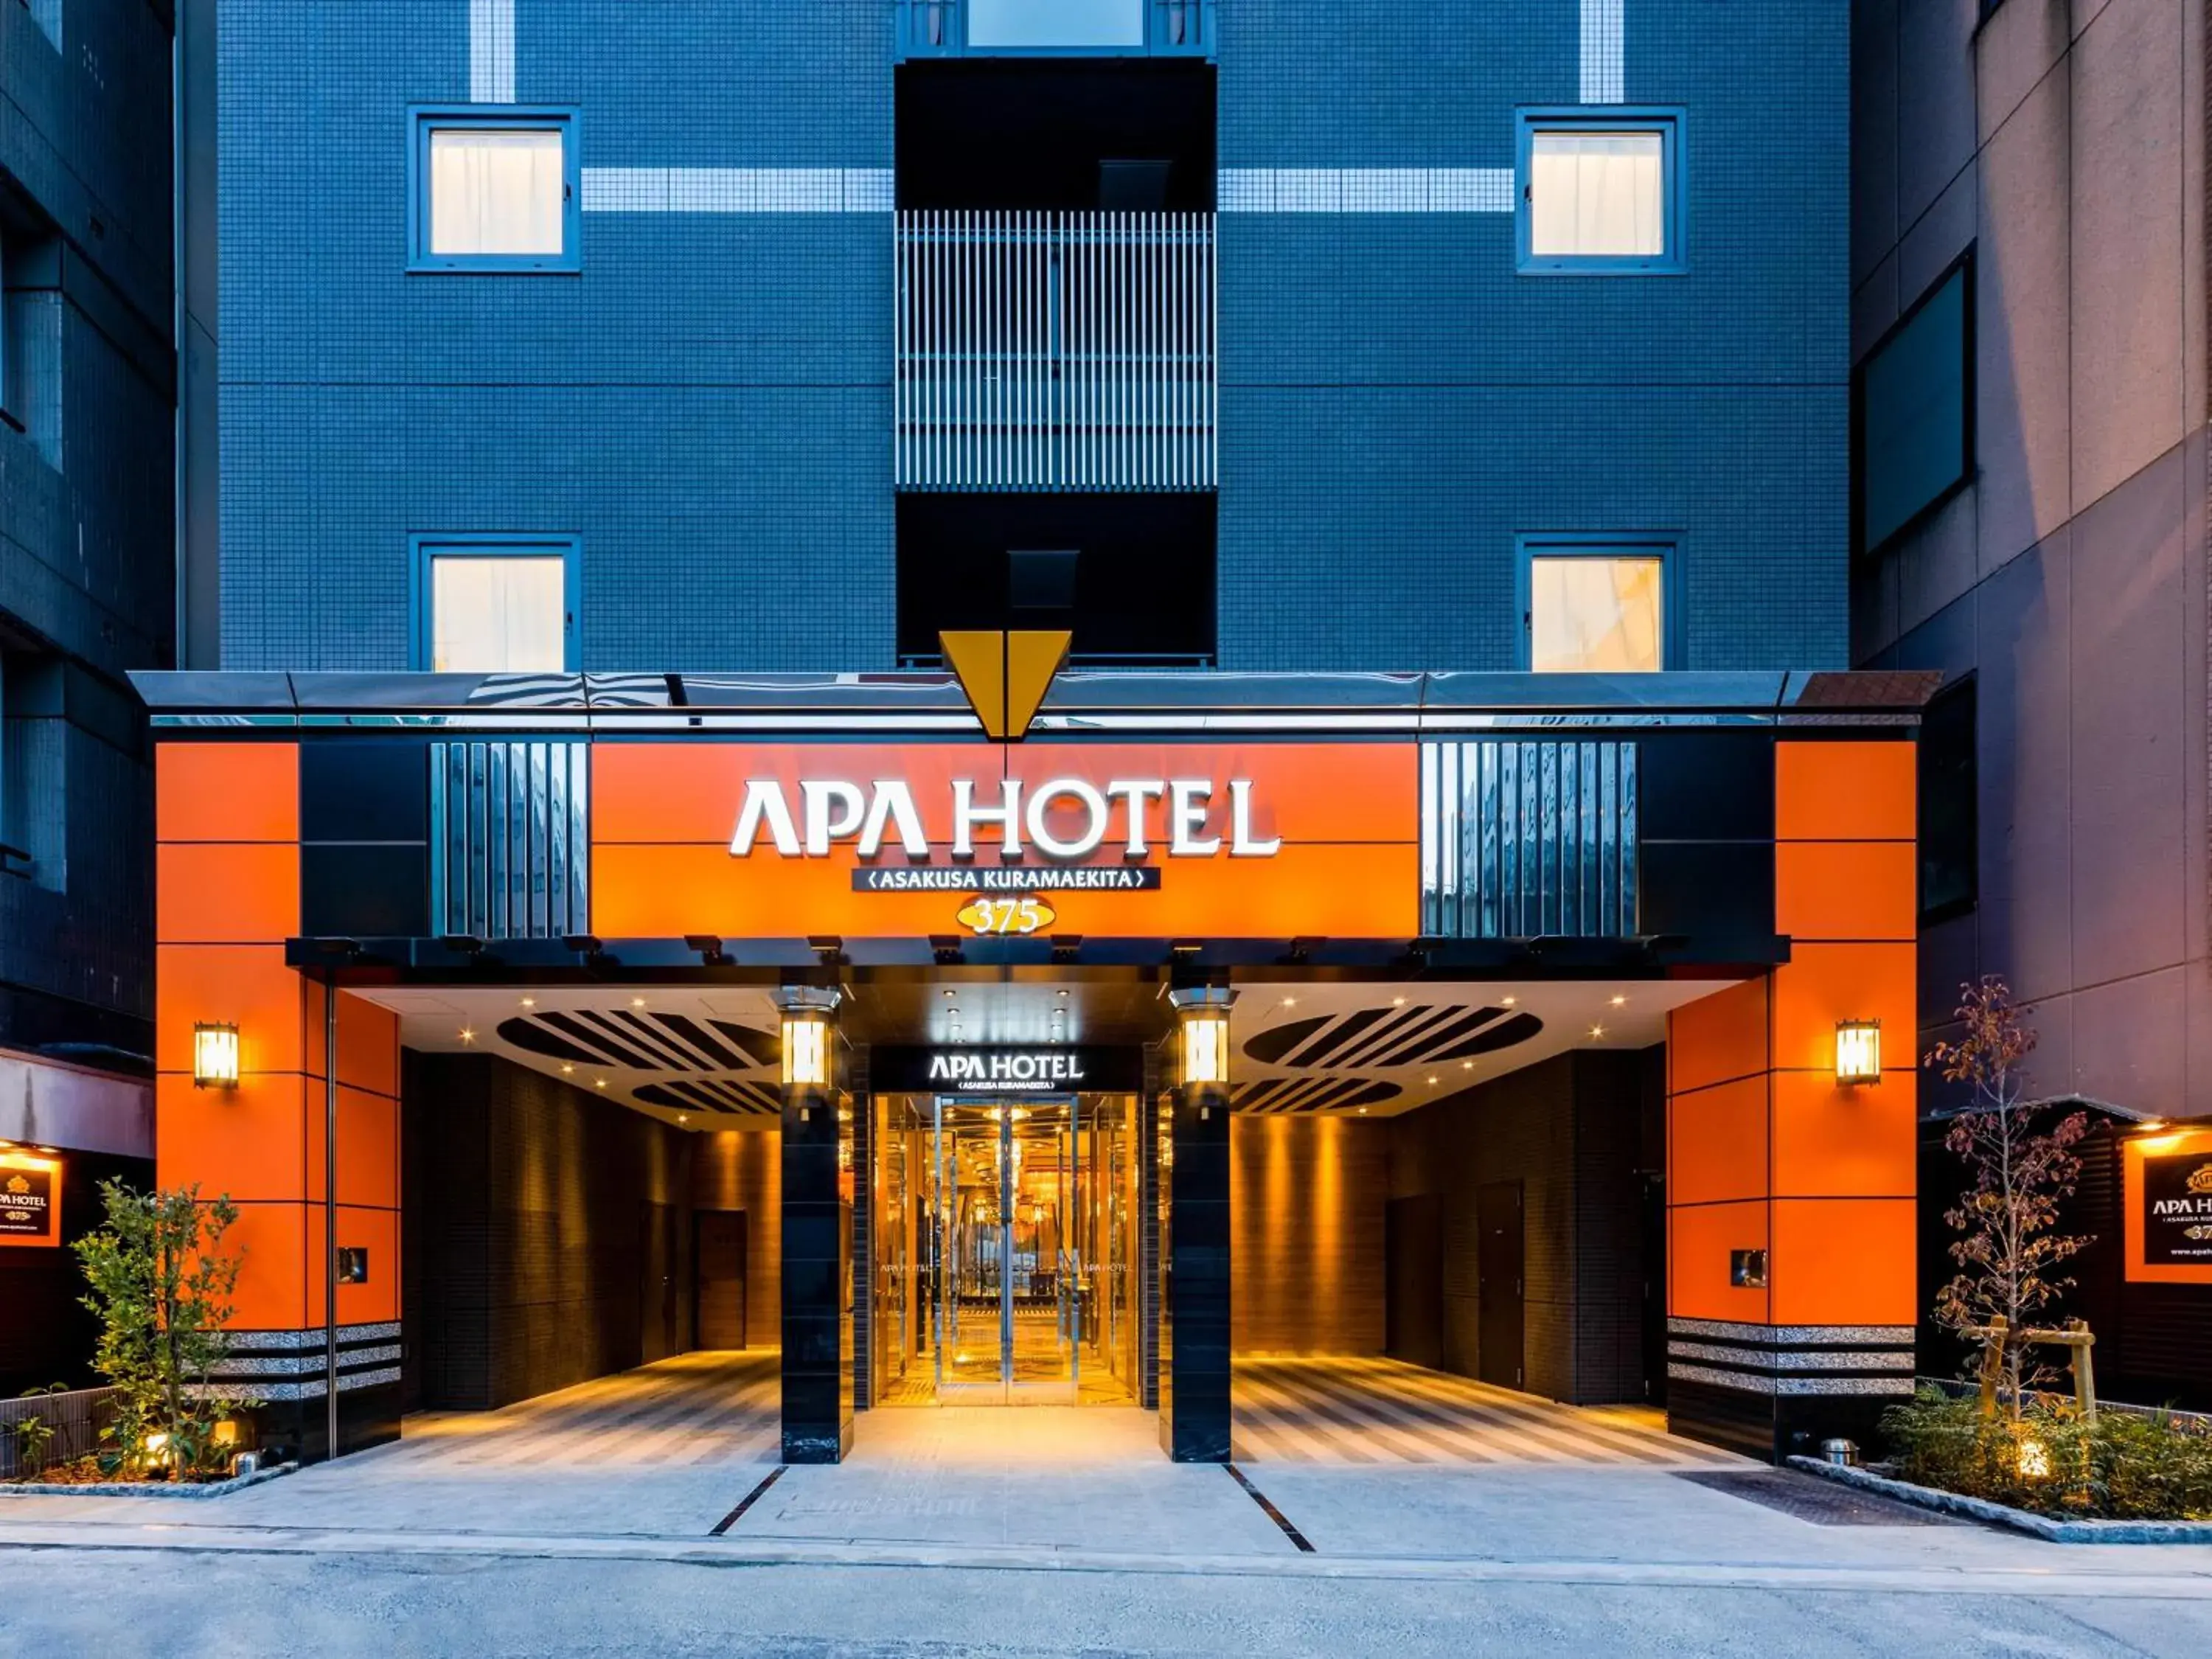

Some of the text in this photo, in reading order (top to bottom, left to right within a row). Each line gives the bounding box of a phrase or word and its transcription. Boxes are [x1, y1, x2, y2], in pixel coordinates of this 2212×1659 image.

[728, 779, 1283, 859] APA HOTEL
[973, 899, 1040, 933] 375
[929, 1055, 1085, 1079] APA HOTEL
[13, 1195, 46, 1207] HOTEL
[2153, 1200, 2193, 1214] APA
